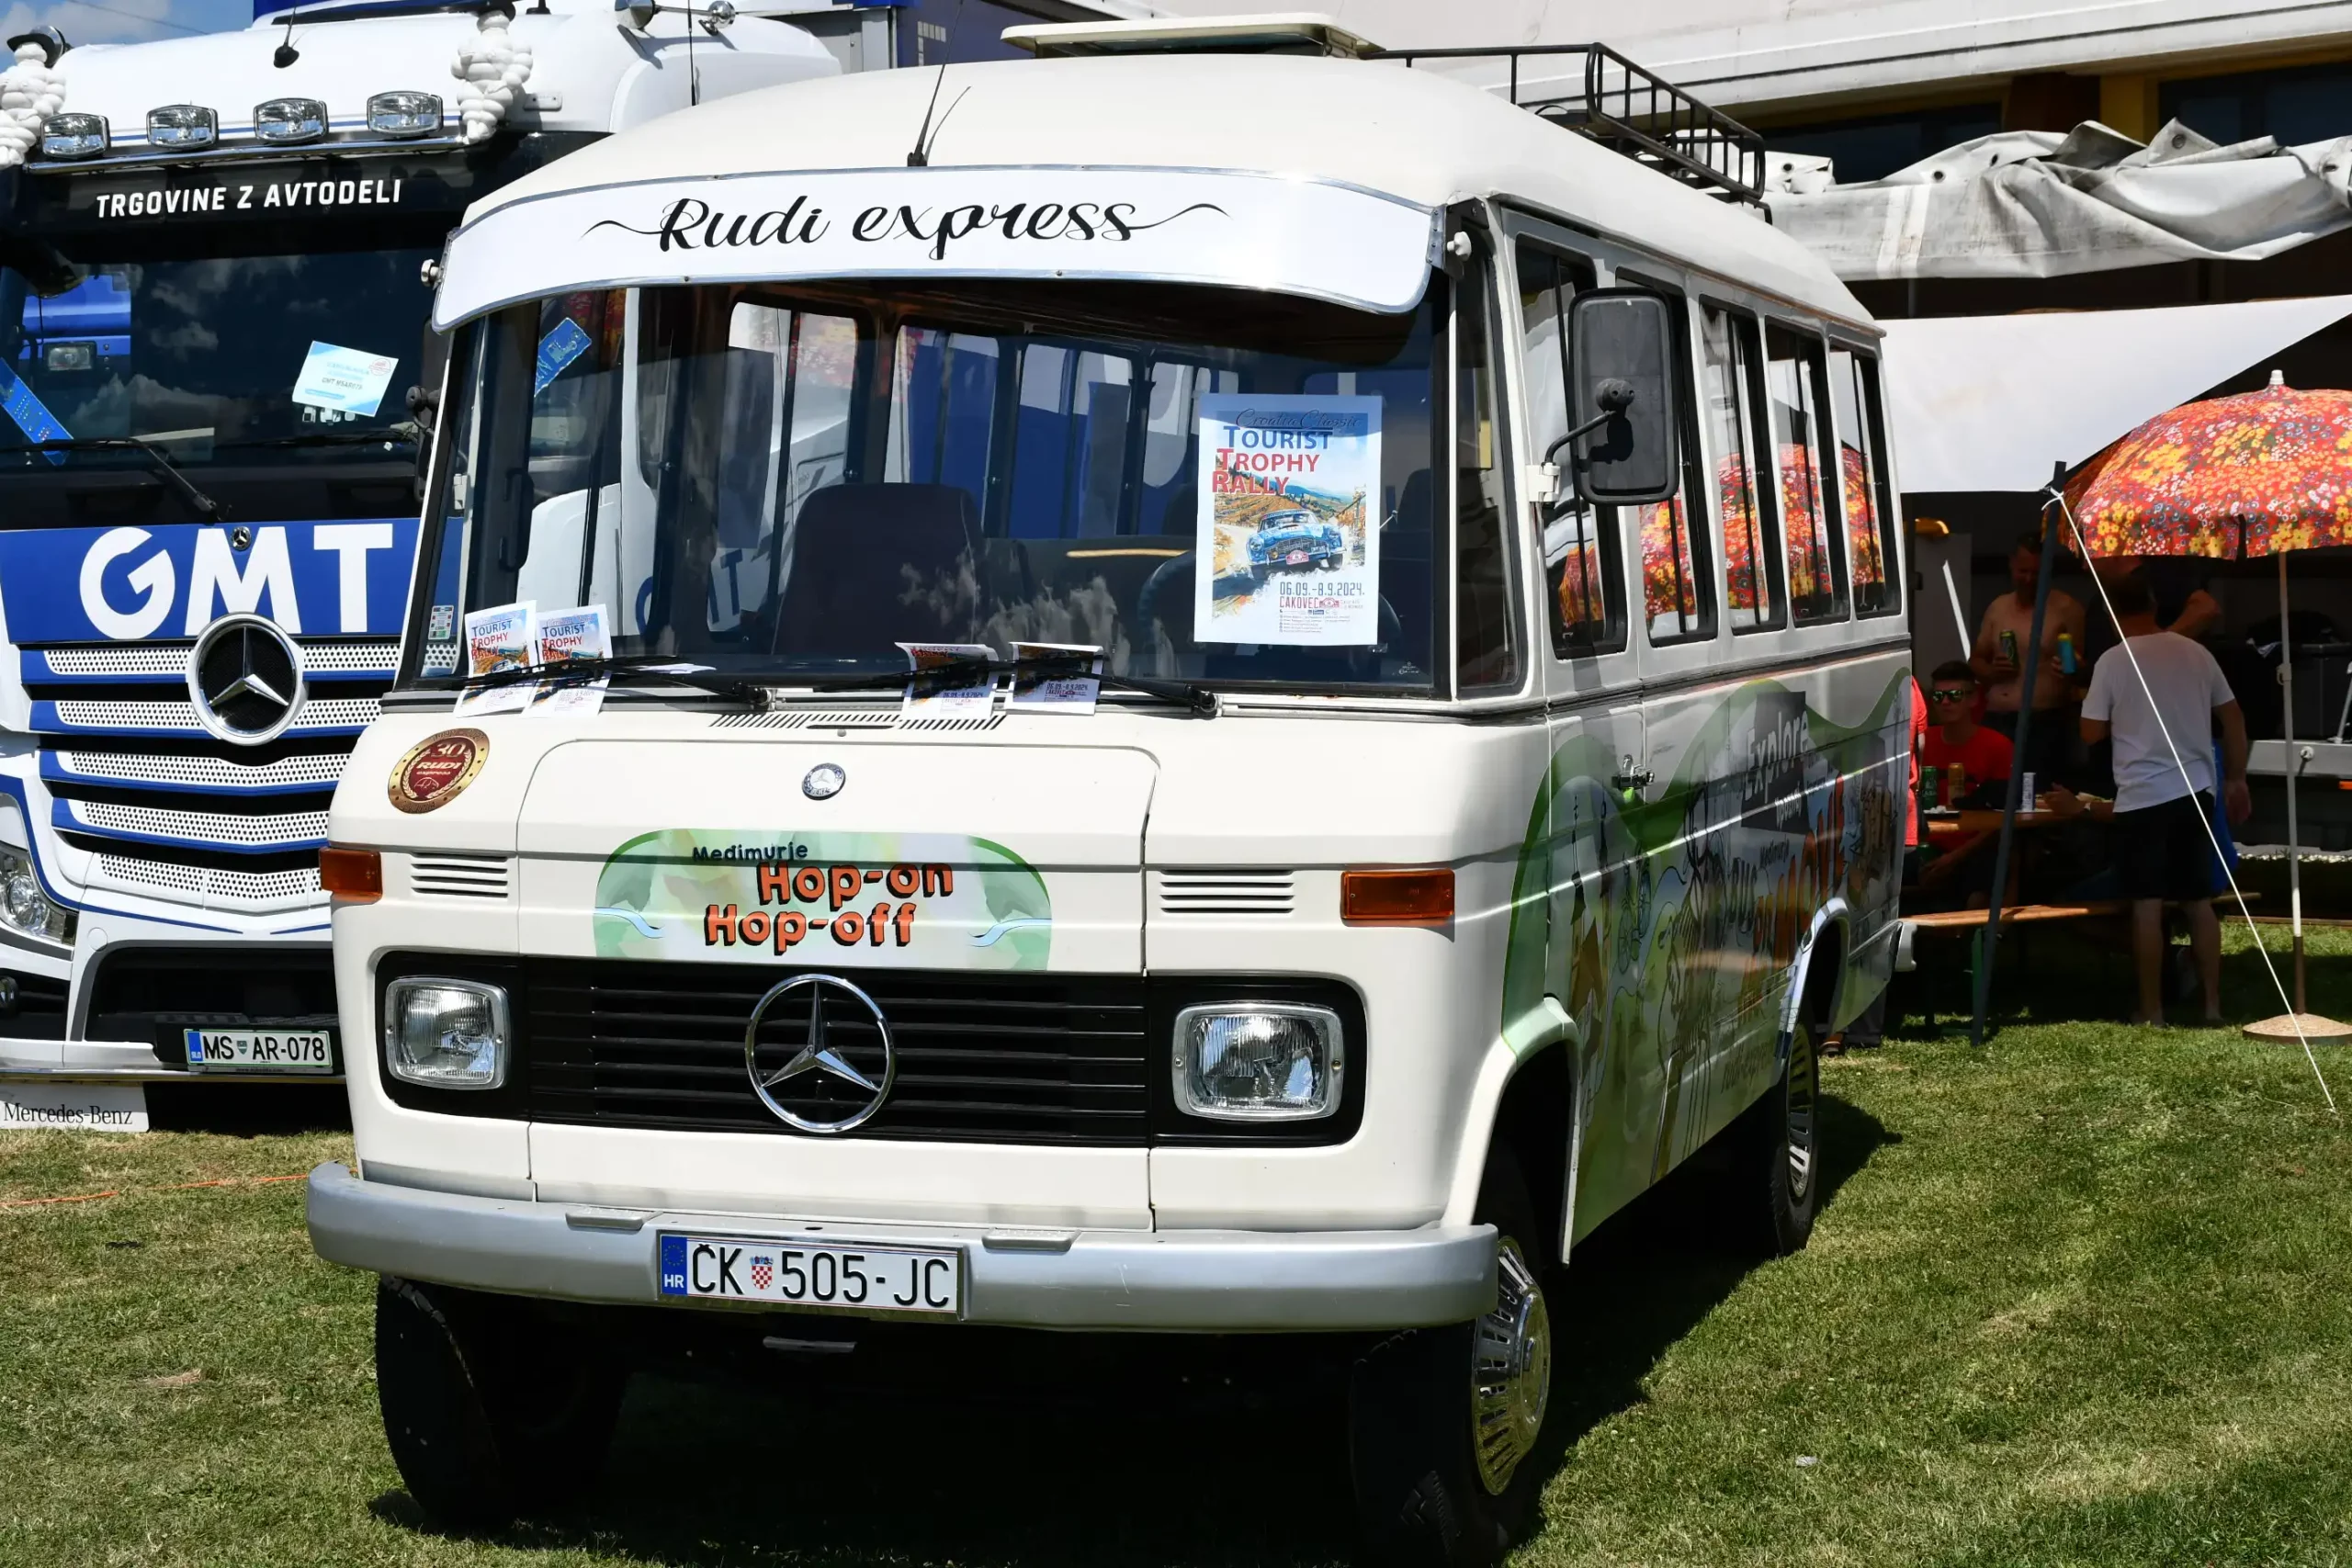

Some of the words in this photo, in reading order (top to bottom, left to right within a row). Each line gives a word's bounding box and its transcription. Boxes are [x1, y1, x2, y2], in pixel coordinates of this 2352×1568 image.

[96, 186, 227, 219] TRGOVINE
[236, 185, 254, 209] Z
[263, 178, 401, 208] AVTODELI
[658, 195, 830, 253] Rudi
[852, 201, 1145, 261] express
[1223, 425, 1333, 450] TOURIST
[1216, 447, 1320, 473] TROPHY
[1212, 470, 1290, 496] RALLY
[79, 524, 393, 640] GMT
[470, 632, 508, 649] TROPHY
[471, 620, 512, 637] TOURIST
[542, 624, 585, 638] TOURIST
[541, 636, 582, 649] TROPHY
[1744, 709, 1811, 805] Explore
[756, 862, 953, 911] Hop-on
[705, 902, 917, 956] Hop-off
[203, 1035, 234, 1059] MS
[253, 1036, 325, 1061] AR-078
[4, 1103, 133, 1124] Mercedes-Benz
[664, 1274, 684, 1289] HR
[692, 1244, 744, 1295] ČK
